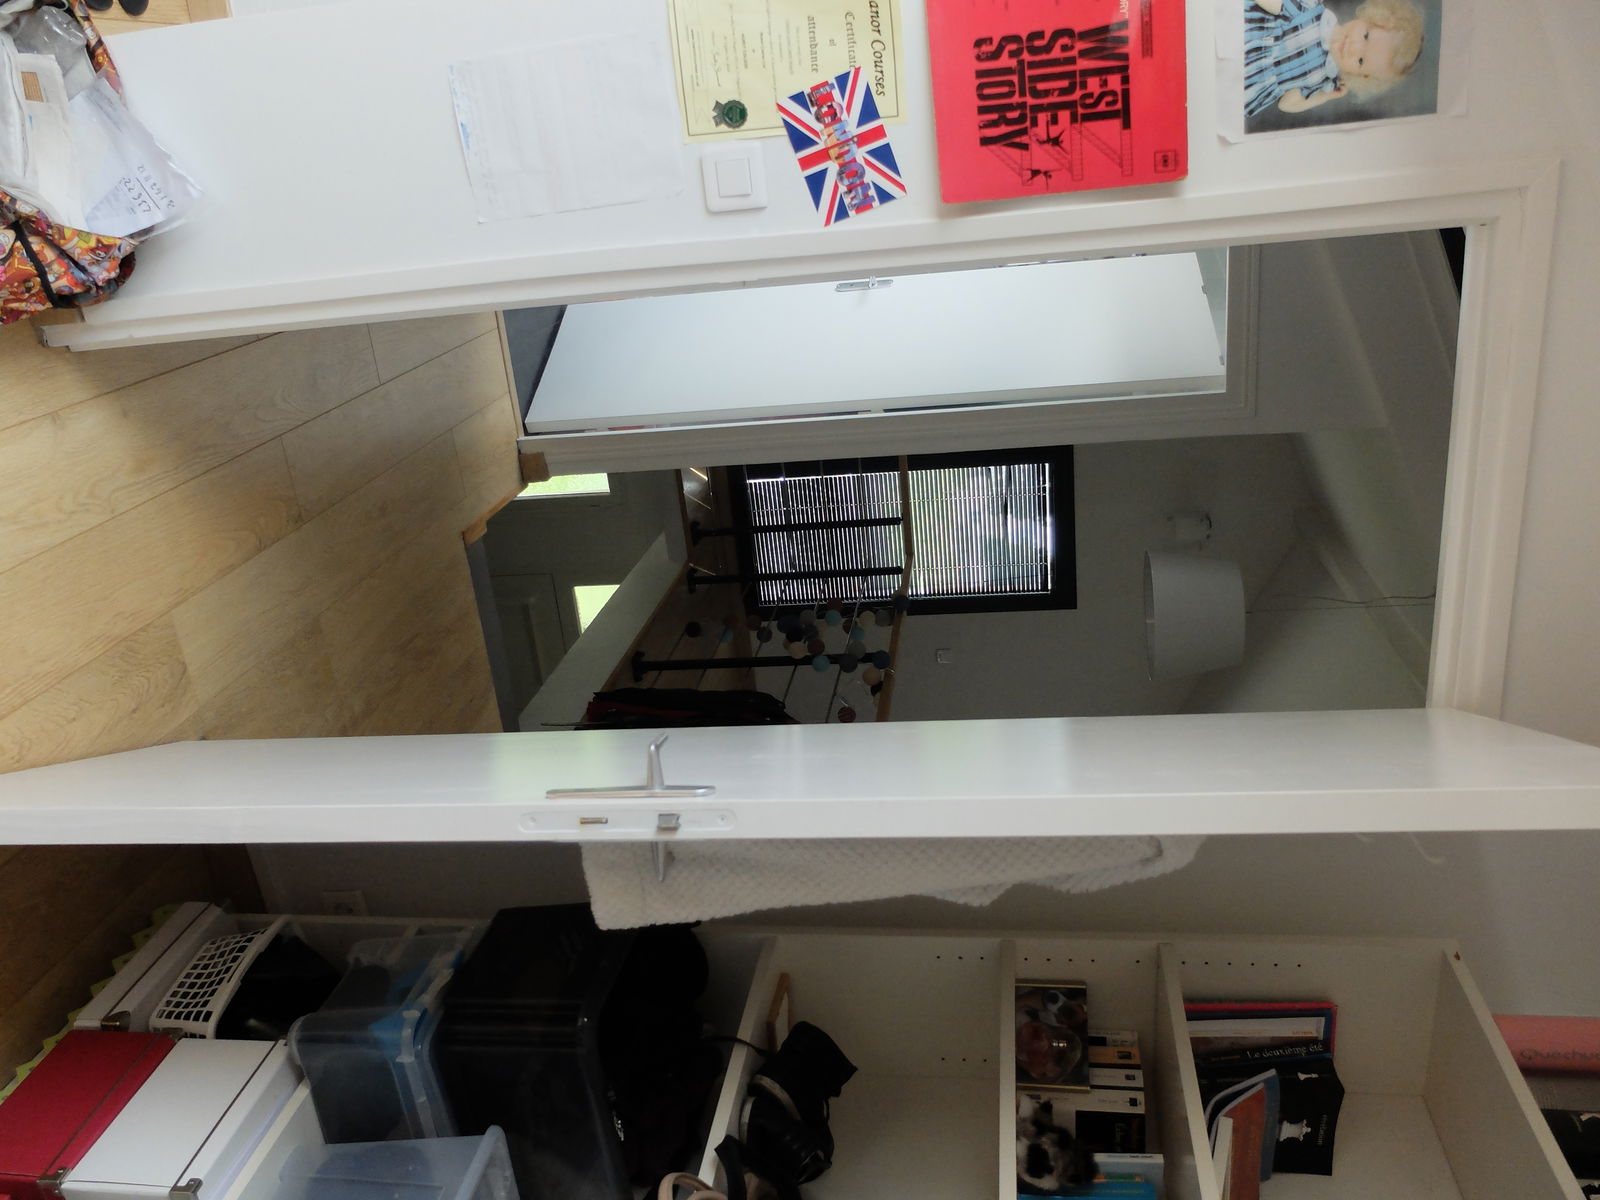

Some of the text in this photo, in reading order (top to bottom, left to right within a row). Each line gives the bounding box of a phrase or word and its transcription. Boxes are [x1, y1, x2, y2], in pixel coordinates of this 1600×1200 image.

[807, 15, 819, 73] attendance
[869, 0, 886, 97] anor Courses
[974, 35, 1029, 151] STORY
[1026, 28, 1080, 129] SIDE
[1077, 20, 1132, 130] WEST
[807, 82, 876, 212] LONDON
